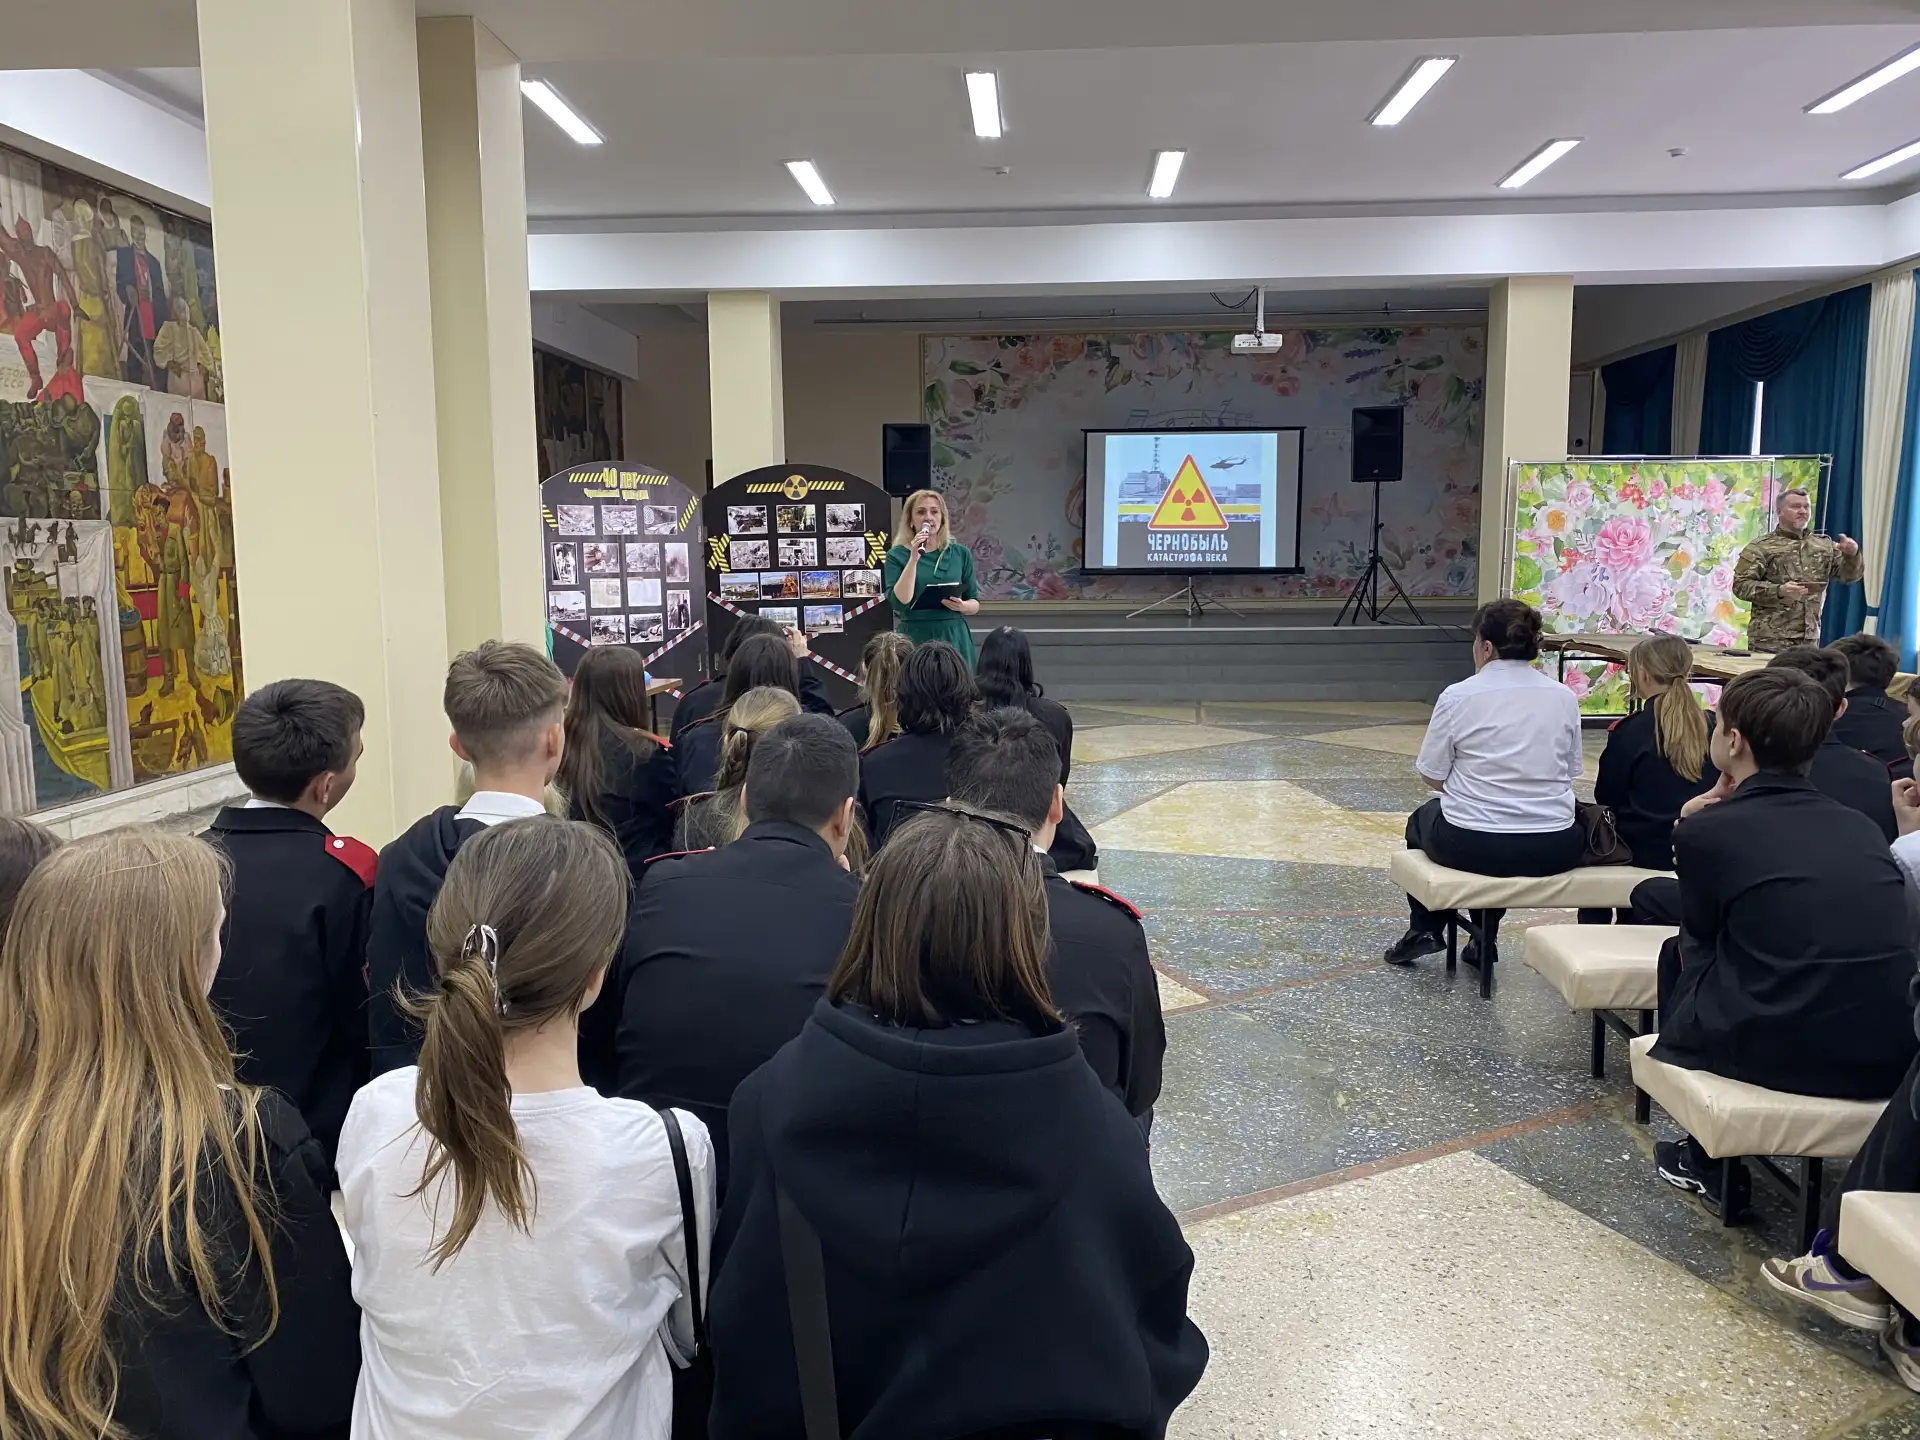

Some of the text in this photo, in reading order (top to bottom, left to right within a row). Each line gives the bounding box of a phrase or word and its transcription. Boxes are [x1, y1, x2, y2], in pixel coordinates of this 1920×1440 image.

[603, 467, 638, 490] 40 лет
[1147, 533, 1229, 552] ЧЕРНОБЫЛЬ
[1147, 553, 1228, 563] КАТАСТРОФА ВЕКА
